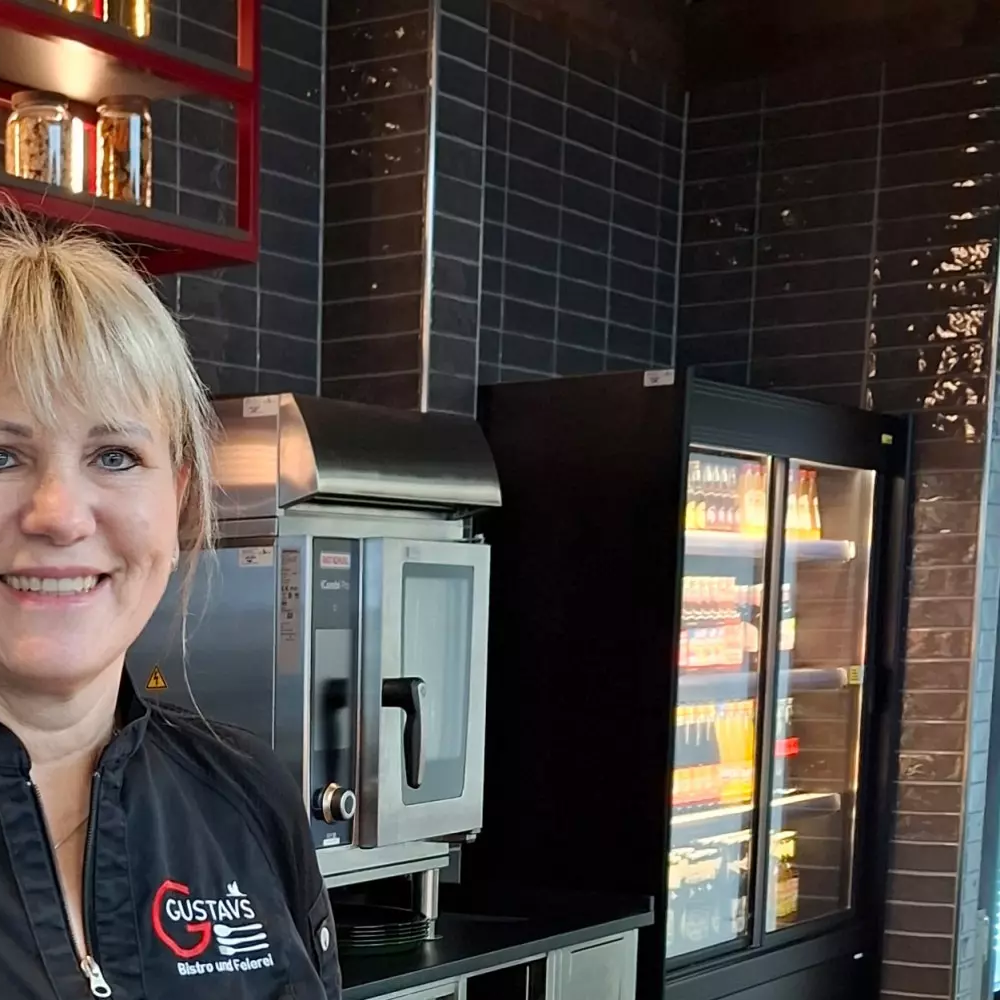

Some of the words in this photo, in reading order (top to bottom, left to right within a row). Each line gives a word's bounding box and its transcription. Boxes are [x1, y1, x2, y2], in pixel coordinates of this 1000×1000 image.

[177, 961, 214, 976] Bistro
[215, 959, 234, 972] und
[233, 953, 274, 972] Feierei
